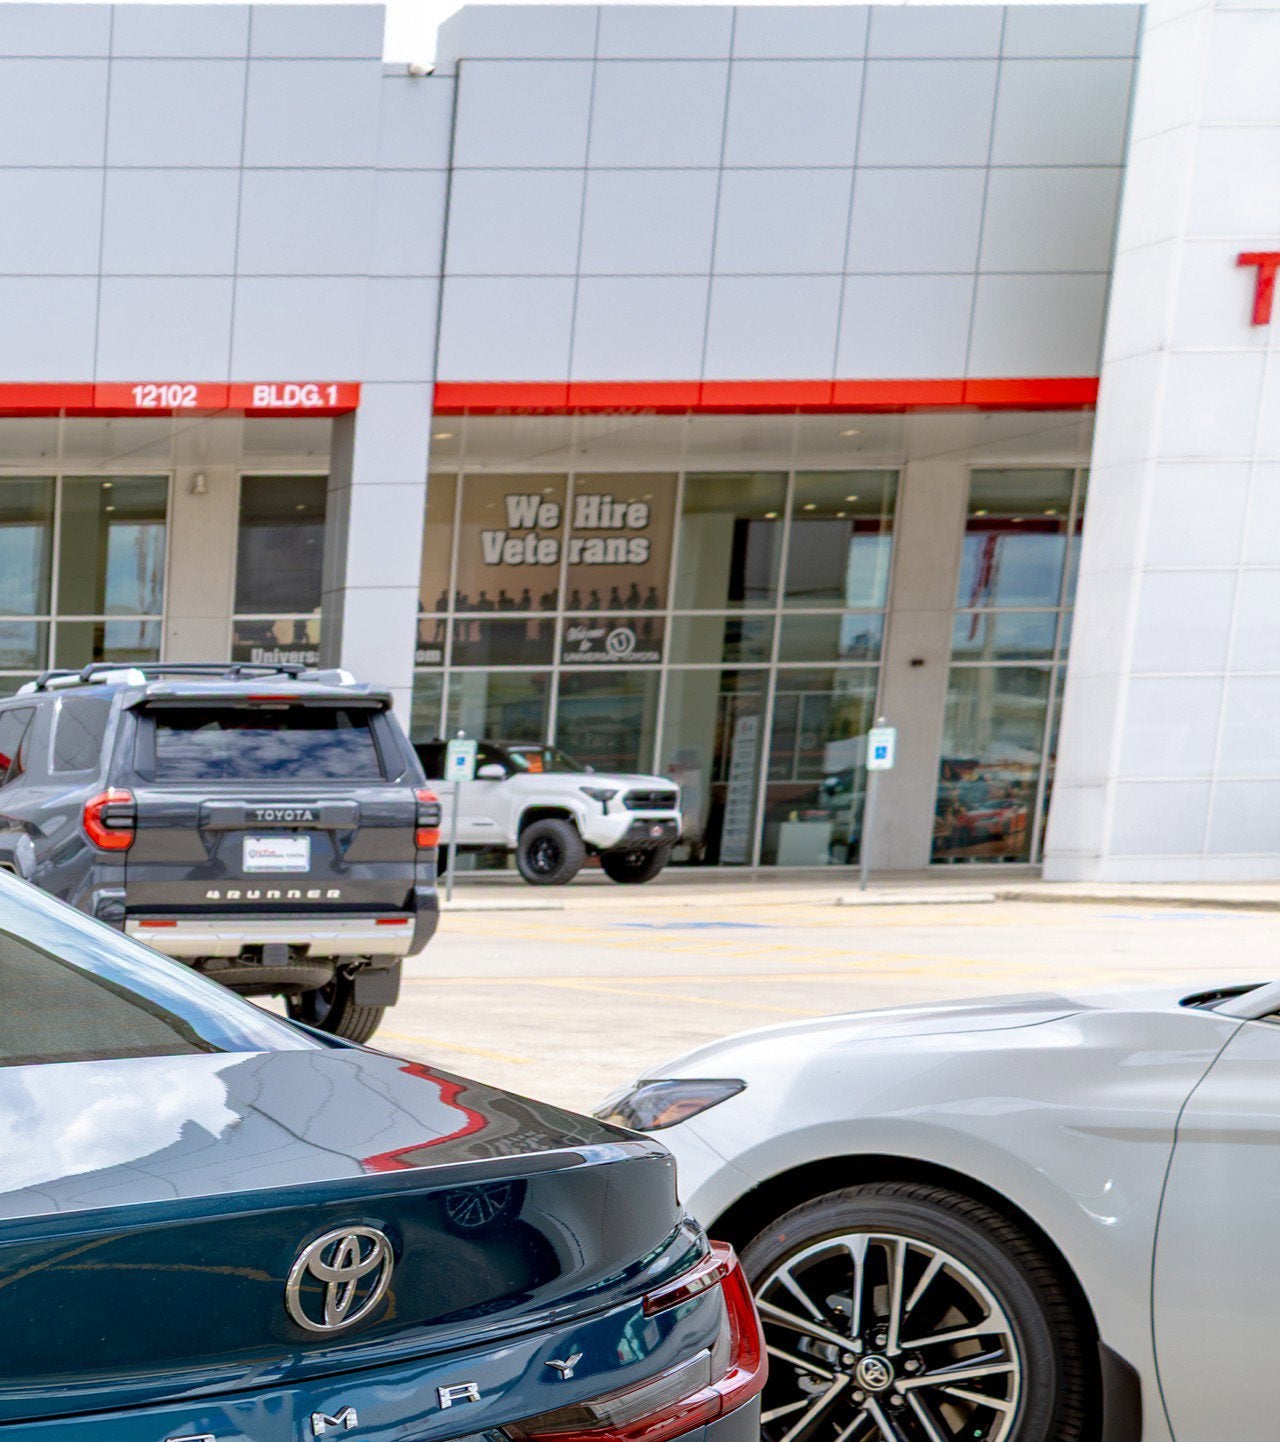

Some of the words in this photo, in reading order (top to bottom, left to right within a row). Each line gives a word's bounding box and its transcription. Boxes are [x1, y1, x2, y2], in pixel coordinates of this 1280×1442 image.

[132, 385, 198, 407] 12102
[327, 385, 338, 407] 1
[505, 494, 561, 529] We
[573, 494, 650, 529] Hire
[481, 530, 651, 566] Veterans
[255, 810, 313, 820] TOYOTA
[206, 889, 341, 899] 4RUNNER
